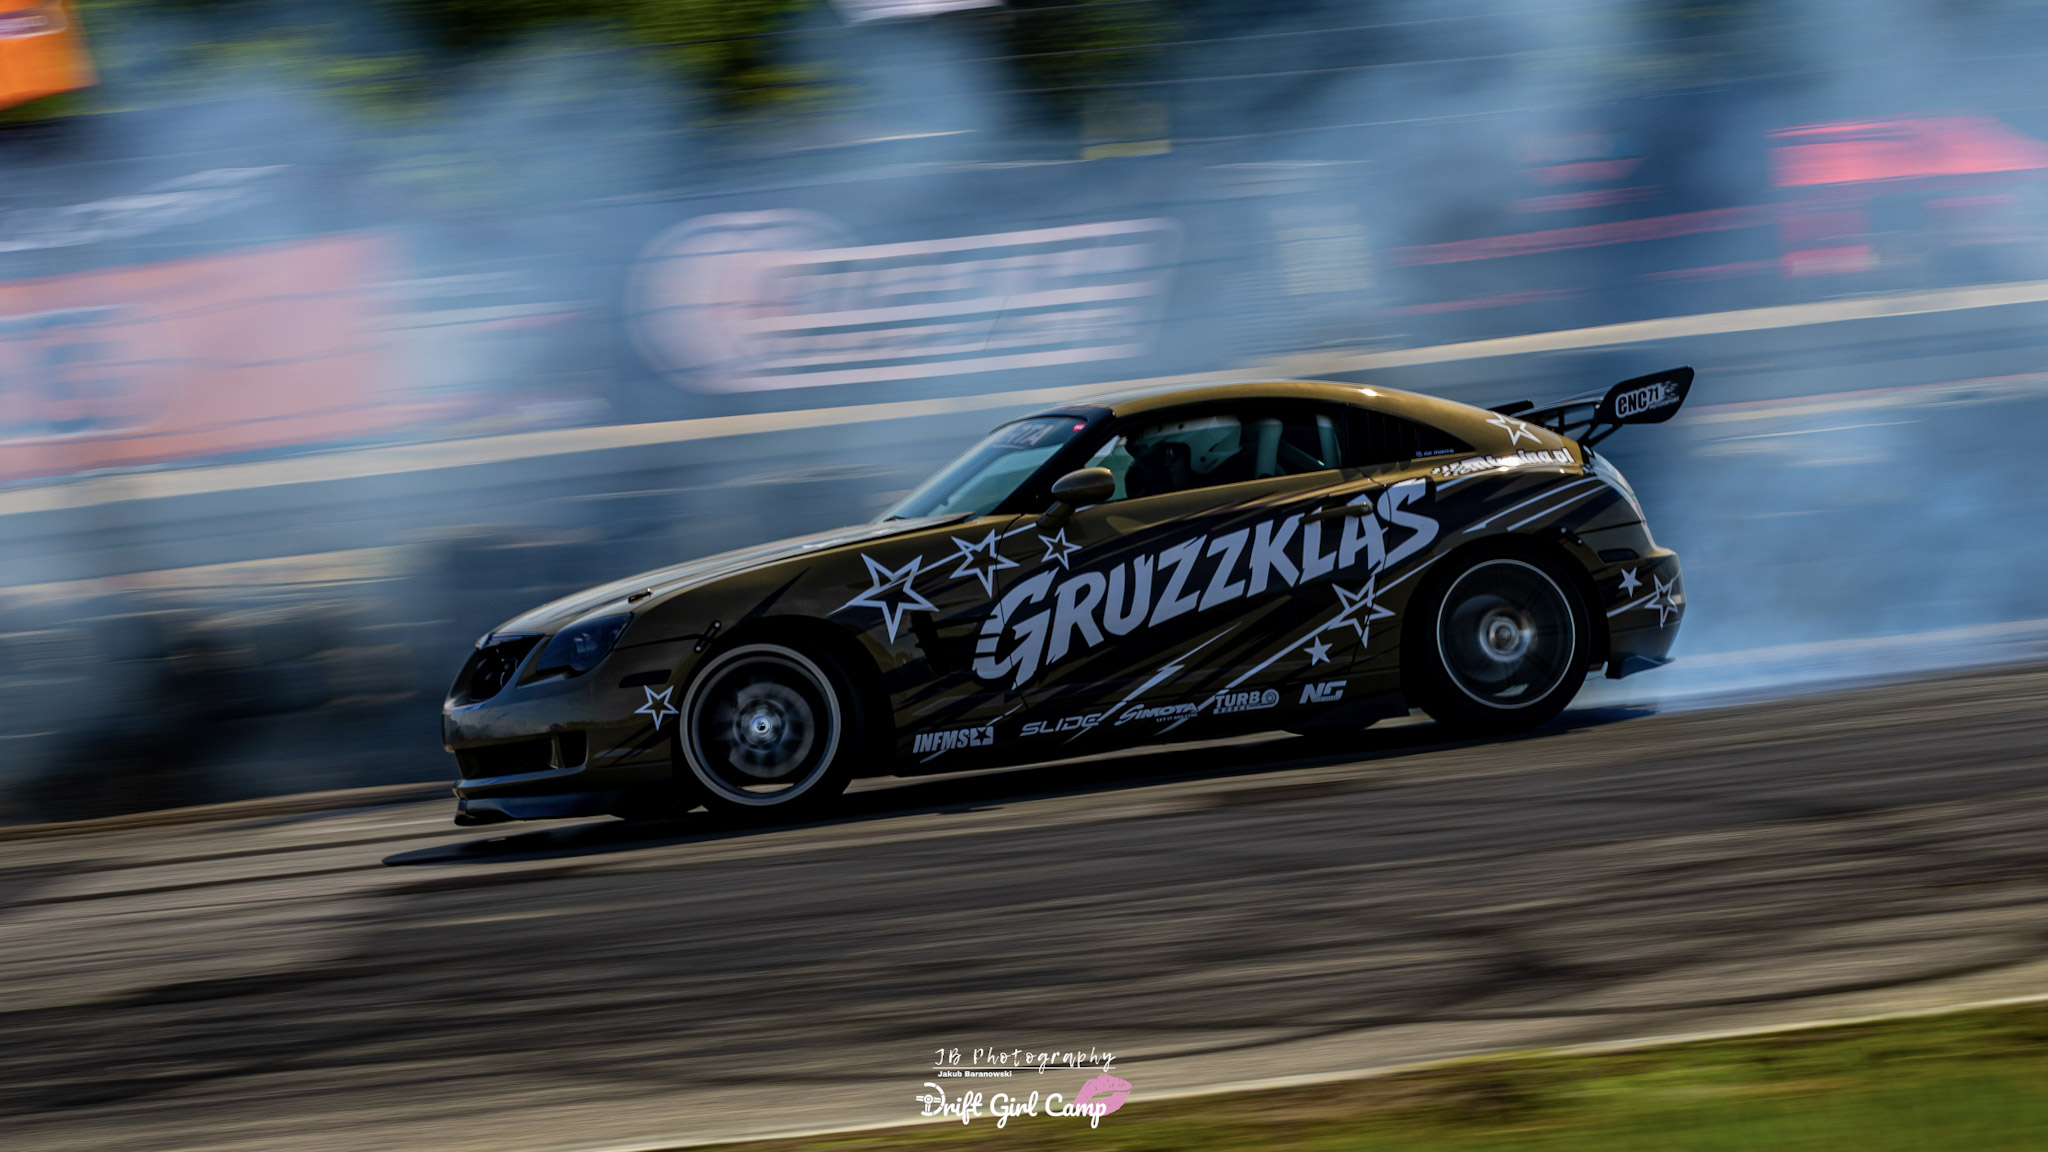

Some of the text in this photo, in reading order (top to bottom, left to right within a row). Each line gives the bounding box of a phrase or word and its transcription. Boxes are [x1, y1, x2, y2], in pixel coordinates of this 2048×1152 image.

[972, 477, 1439, 690] GRUZZKLAS
[1019, 712, 1102, 737] SLIDE
[1114, 702, 1199, 727] SIMOTA
[912, 728, 970, 754] INFMS
